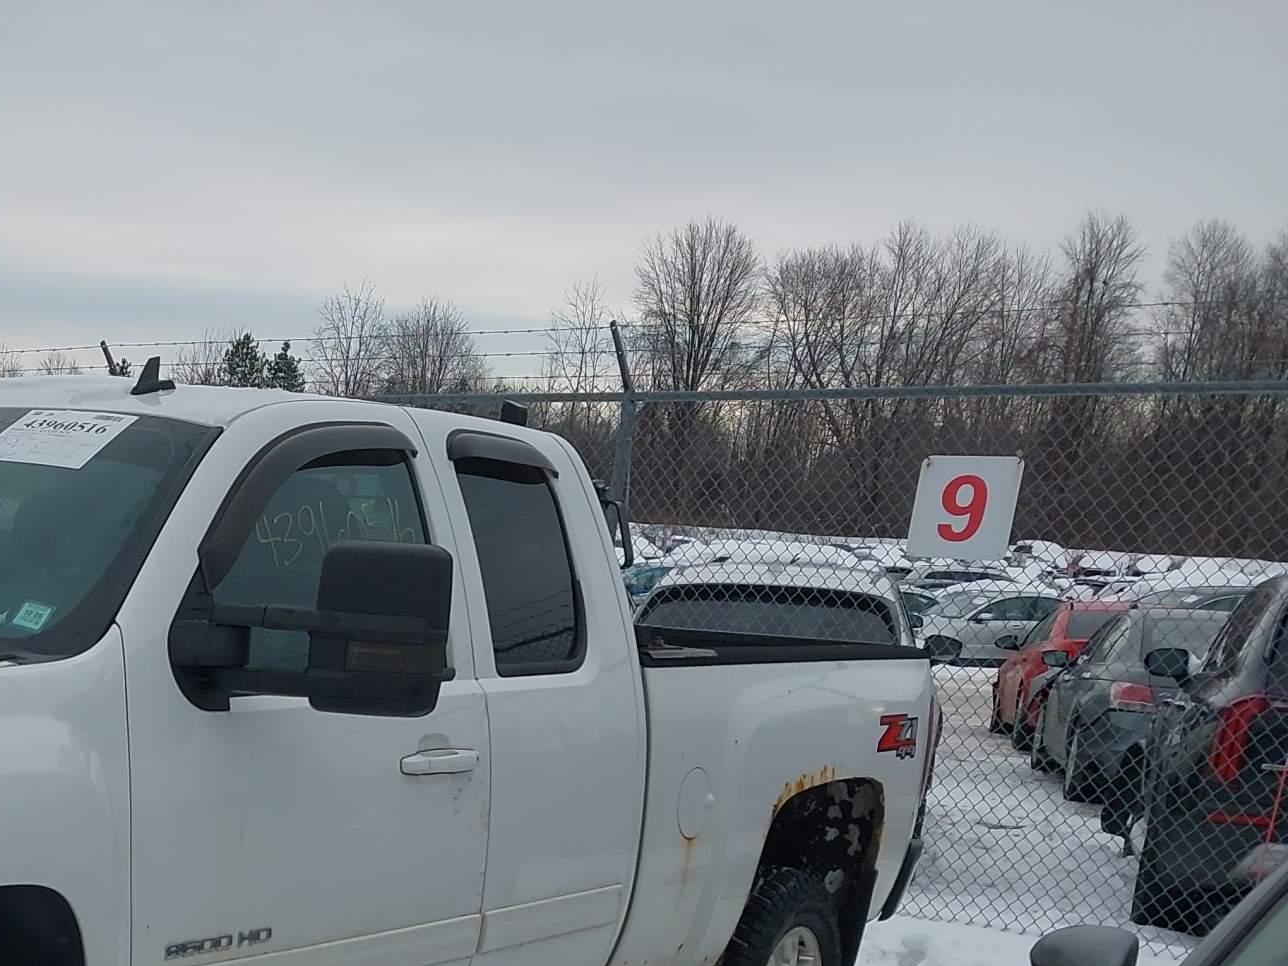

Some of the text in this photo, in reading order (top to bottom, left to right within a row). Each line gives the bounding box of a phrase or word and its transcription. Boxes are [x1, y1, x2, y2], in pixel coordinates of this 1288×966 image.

[23, 419, 112, 435] 43960516
[937, 474, 988, 542] 9
[877, 713, 918, 752] Z71
[237, 927, 272, 948] HD
